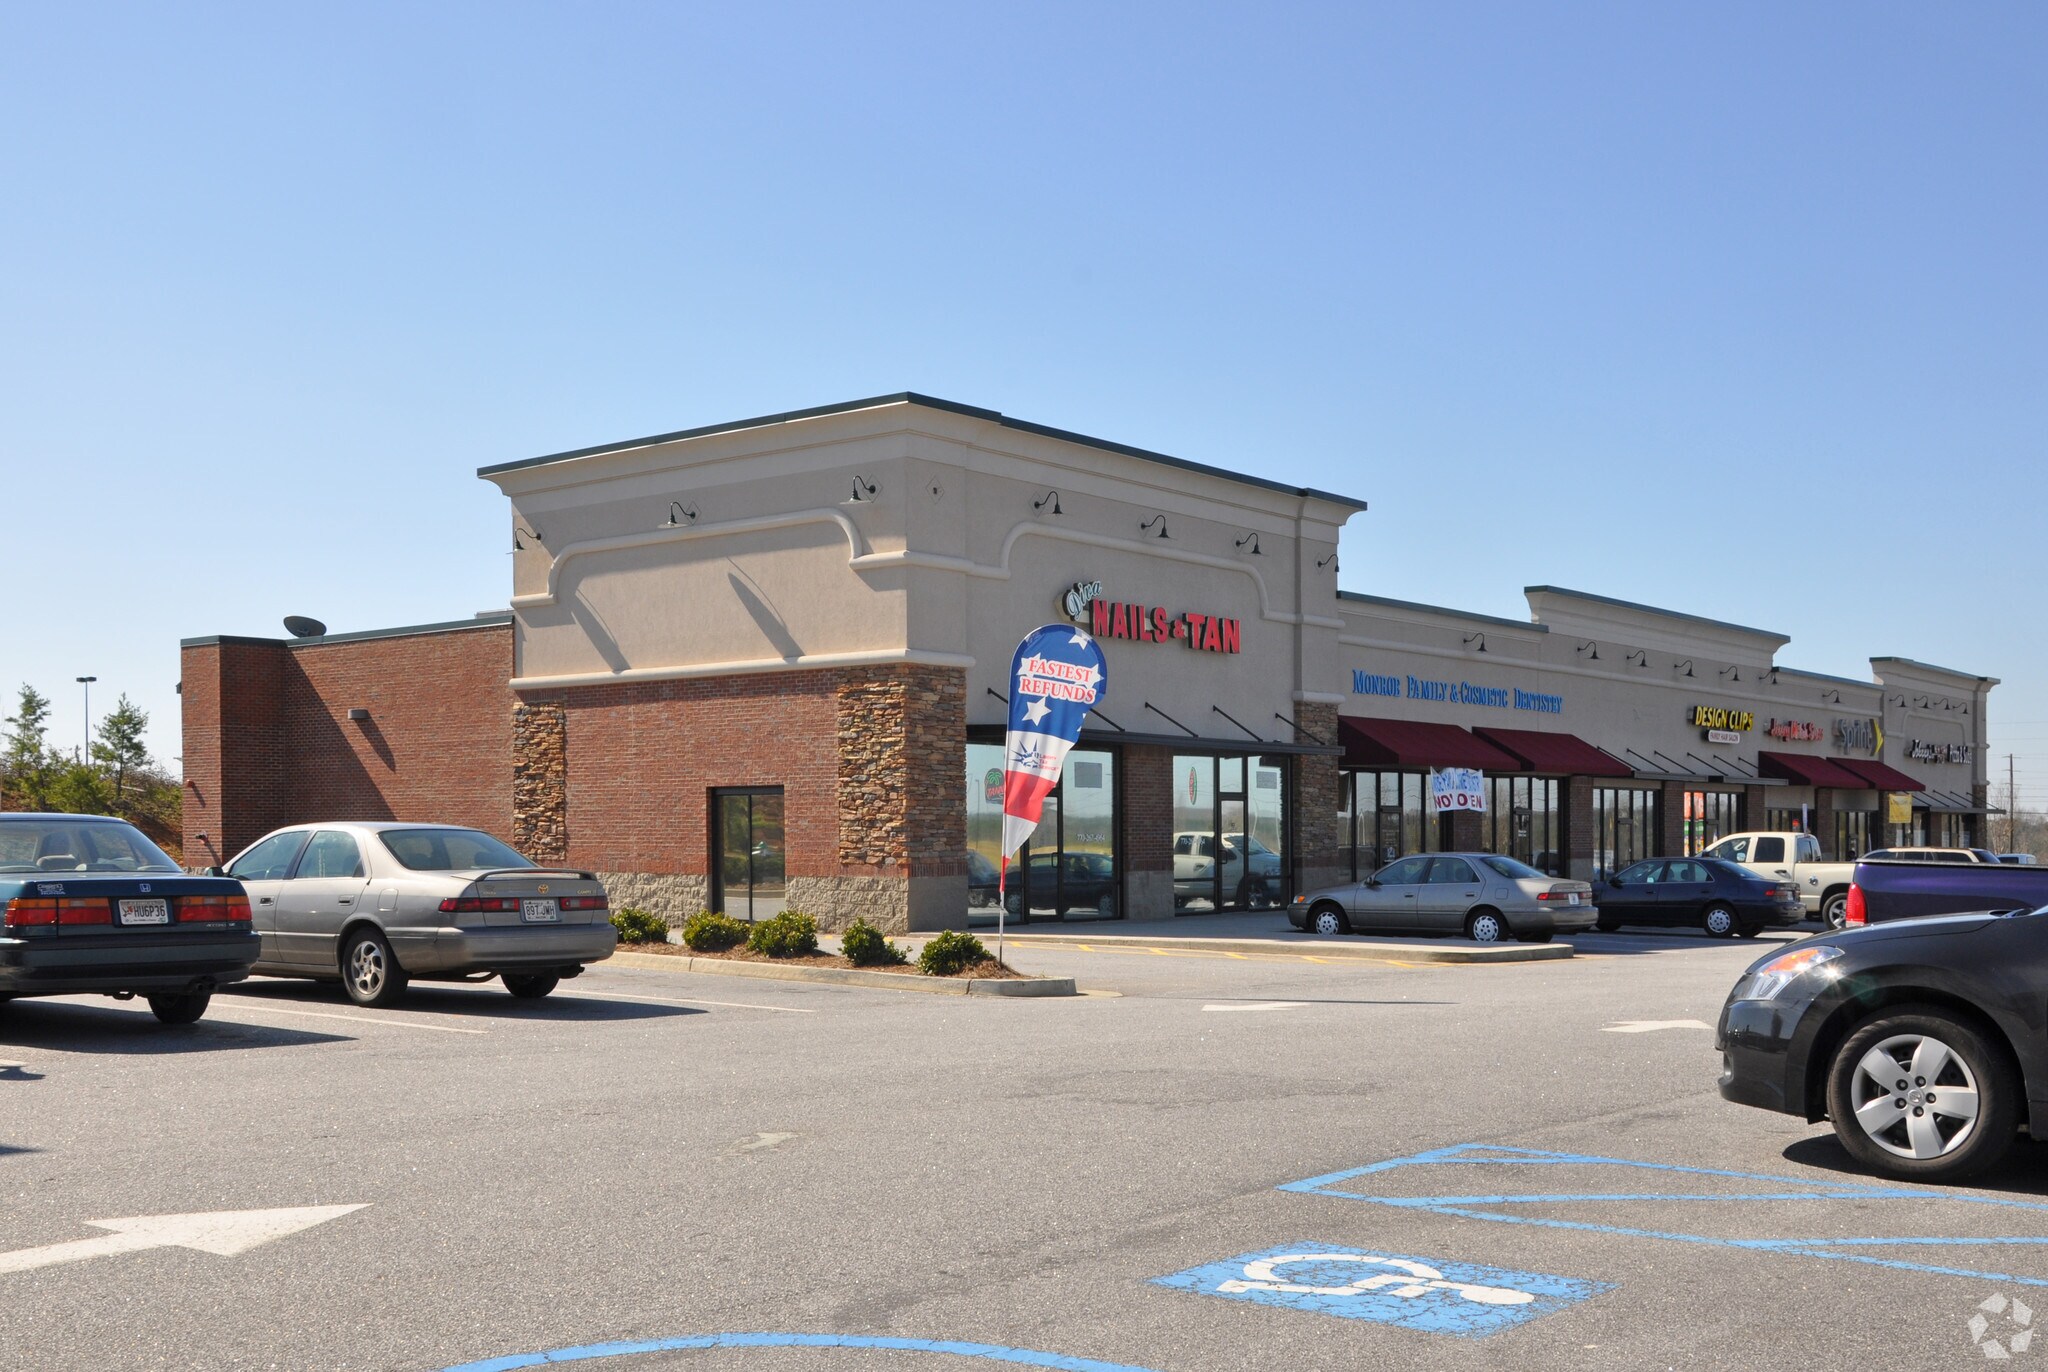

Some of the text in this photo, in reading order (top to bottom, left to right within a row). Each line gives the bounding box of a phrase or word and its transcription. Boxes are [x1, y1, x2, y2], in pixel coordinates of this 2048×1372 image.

[1066, 580, 1102, 619] Diva
[1089, 600, 1240, 654] NAILS & TAN
[1028, 659, 1093, 682] FASTEST
[1021, 678, 1096, 703] REFUNDS
[1406, 675, 1447, 702] FAMILY
[1459, 681, 1508, 707] COSMETIC
[1513, 687, 1562, 714] DENTISTRY
[1695, 705, 1727, 729] DESIGN
[1728, 710, 1753, 731] CLIPS
[1840, 720, 1871, 753] Sprint
[1457, 793, 1482, 808] OEN
[133, 905, 166, 918] HU6P36
